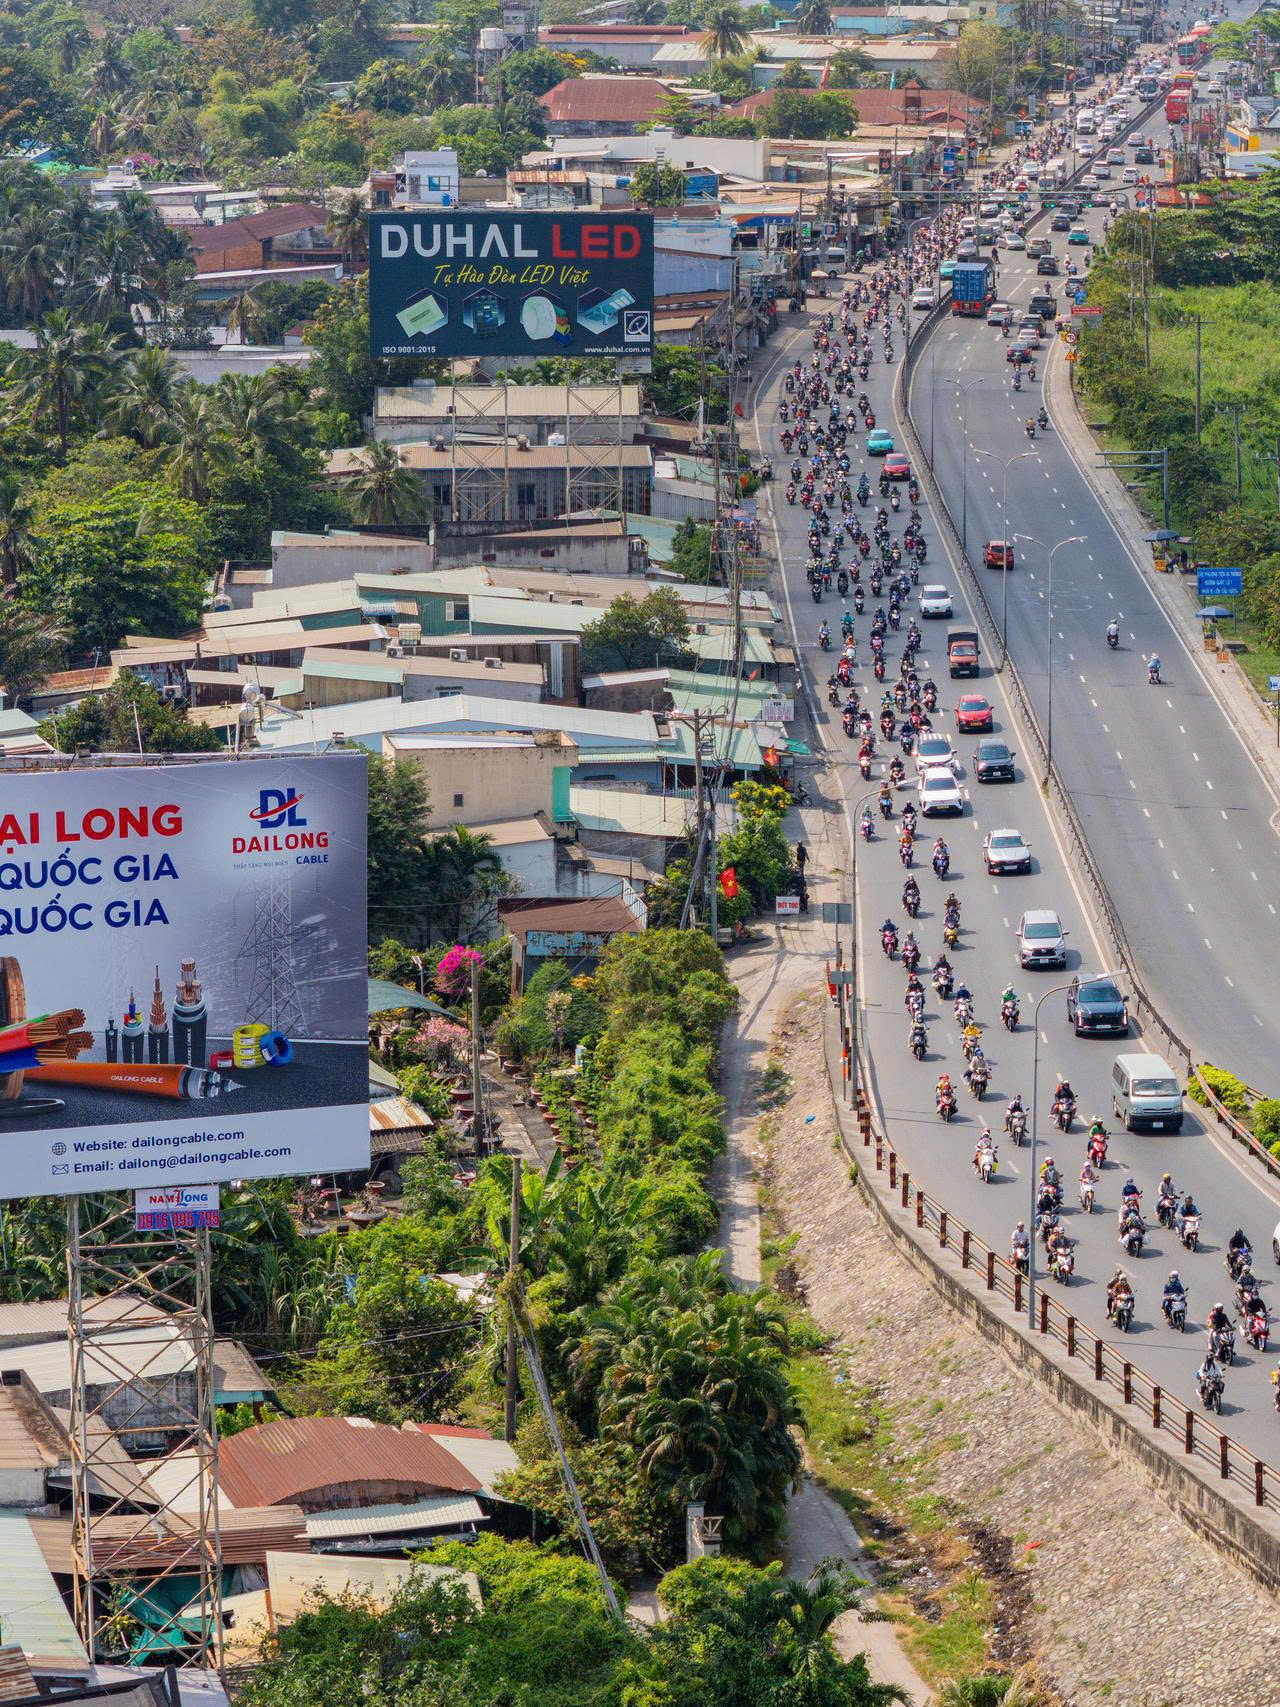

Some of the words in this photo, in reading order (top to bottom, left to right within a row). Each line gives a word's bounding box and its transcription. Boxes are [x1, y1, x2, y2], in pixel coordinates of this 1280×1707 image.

[381, 224, 538, 258] DUHAL
[552, 224, 641, 259] LED
[433, 264, 453, 287] Tự
[456, 263, 484, 284] Hào
[488, 265, 516, 284] Đèn
[519, 264, 555, 284] LED
[559, 265, 590, 287] Việt
[259, 788, 307, 829] DL
[56, 804, 183, 843] LONG
[232, 831, 329, 854] DAILONG
[0, 847, 103, 890] QUỐC
[113, 853, 179, 882] GIA
[296, 854, 329, 865] CABLE
[104, 898, 170, 928] GIA
[140, 1075, 164, 1084] CABLE
[73, 1139, 127, 1153] Website:
[132, 1131, 245, 1148] dailongcable.com
[74, 1160, 114, 1173] Email:
[118, 1147, 291, 1170] dailong@dailongcable.com
[137, 1213, 168, 1229] 0916
[171, 1211, 193, 1228] 095
[198, 1210, 219, 1226] 795
